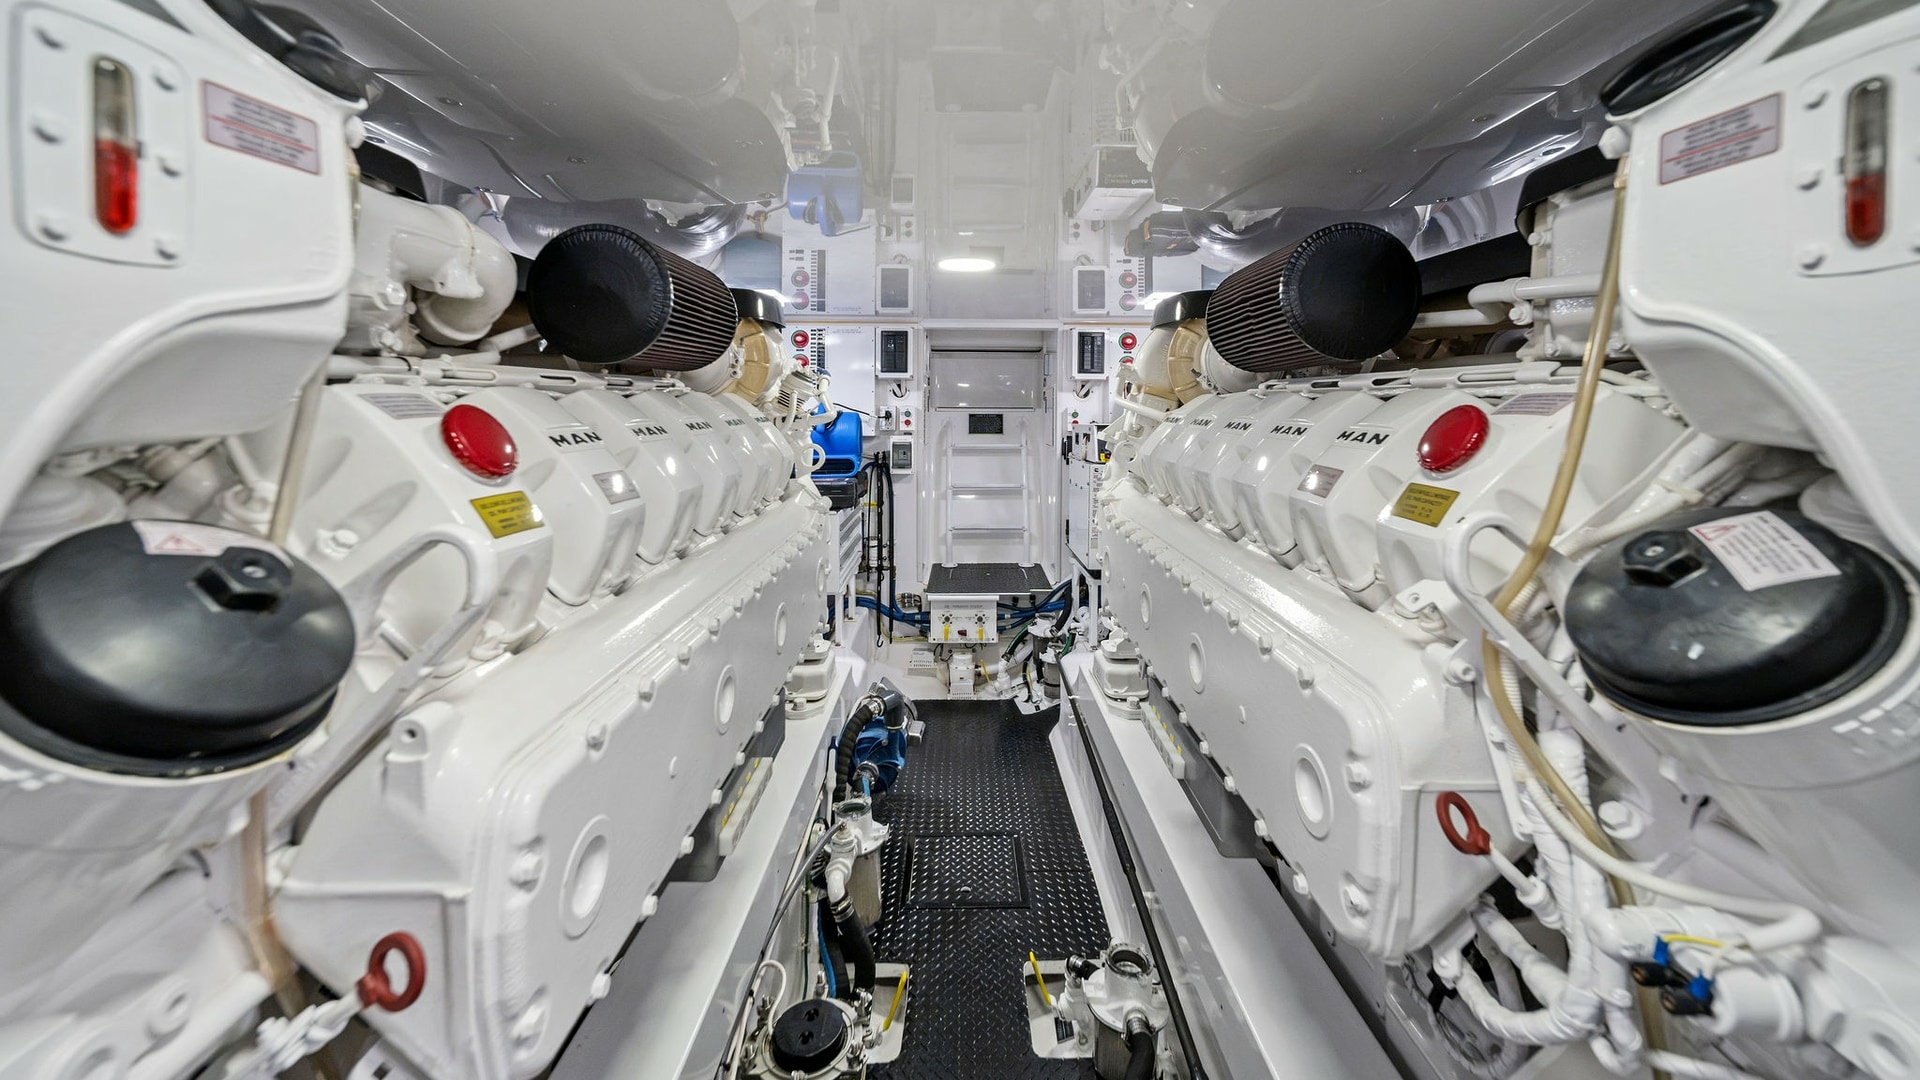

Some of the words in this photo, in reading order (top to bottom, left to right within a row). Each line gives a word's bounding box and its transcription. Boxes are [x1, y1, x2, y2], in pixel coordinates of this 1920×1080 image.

[632, 425, 668, 437] MAN
[685, 421, 712, 432] MAN
[1224, 421, 1251, 432] MAN
[1270, 425, 1307, 436] MAN
[548, 431, 603, 448] MAN
[1336, 430, 1390, 446] MAN
